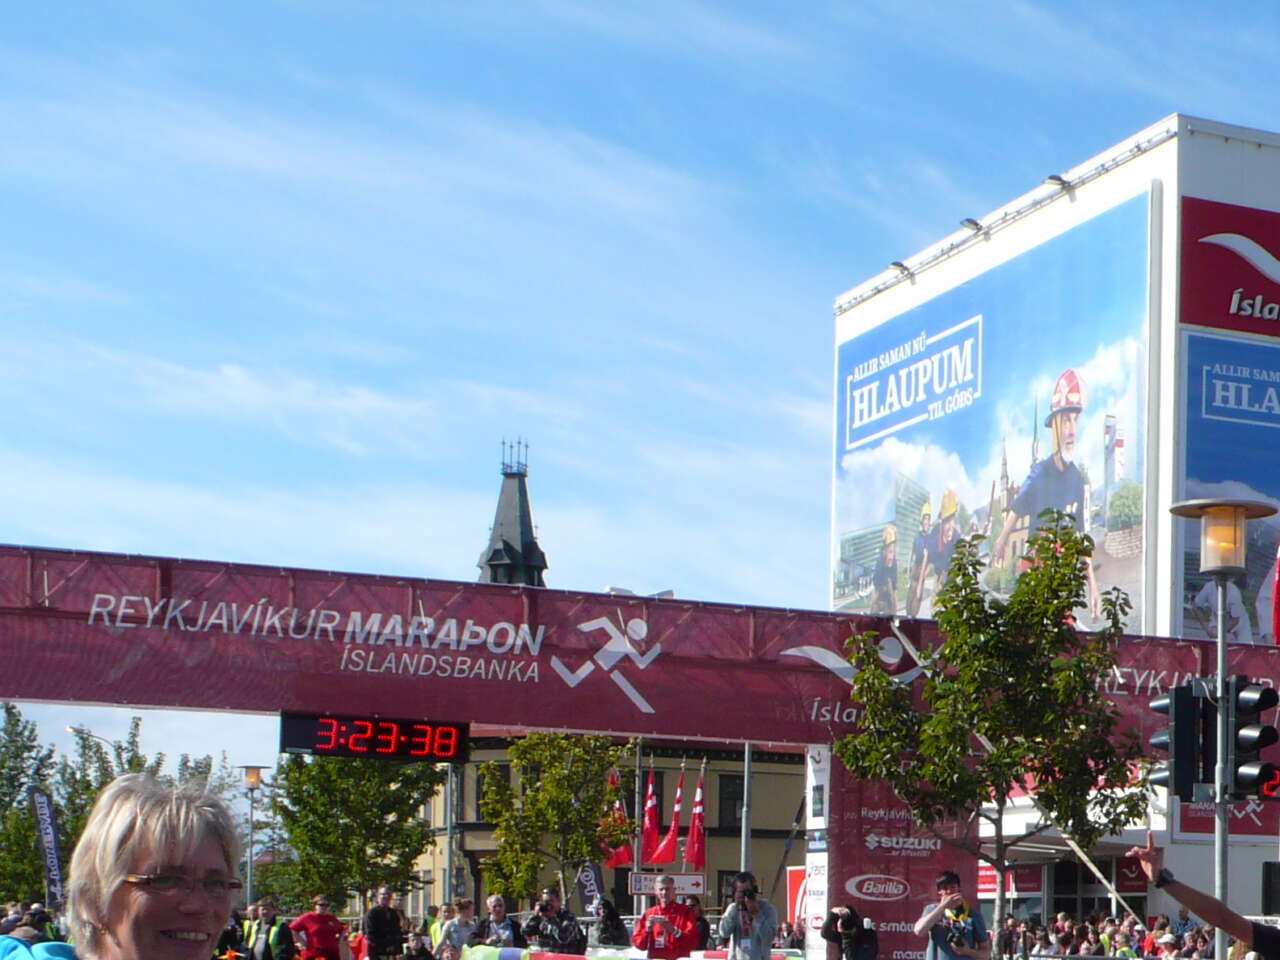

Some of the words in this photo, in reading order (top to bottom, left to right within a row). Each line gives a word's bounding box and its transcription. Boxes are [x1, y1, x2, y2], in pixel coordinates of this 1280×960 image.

[853, 357, 878, 382] ALLIR
[879, 340, 913, 369] SAMAN
[912, 330, 926, 355] NÚ
[1212, 363, 1251, 378] ALLIR
[852, 337, 975, 430] HLAUPUM
[927, 402, 945, 421] TIL
[87, 592, 341, 642] REYKJAVÍKUR
[343, 611, 545, 657] MARAÞON
[340, 644, 541, 683] ÍSLANDSBANKA
[881, 836, 941, 850] SUZUKI
[862, 880, 905, 894] Barilla
